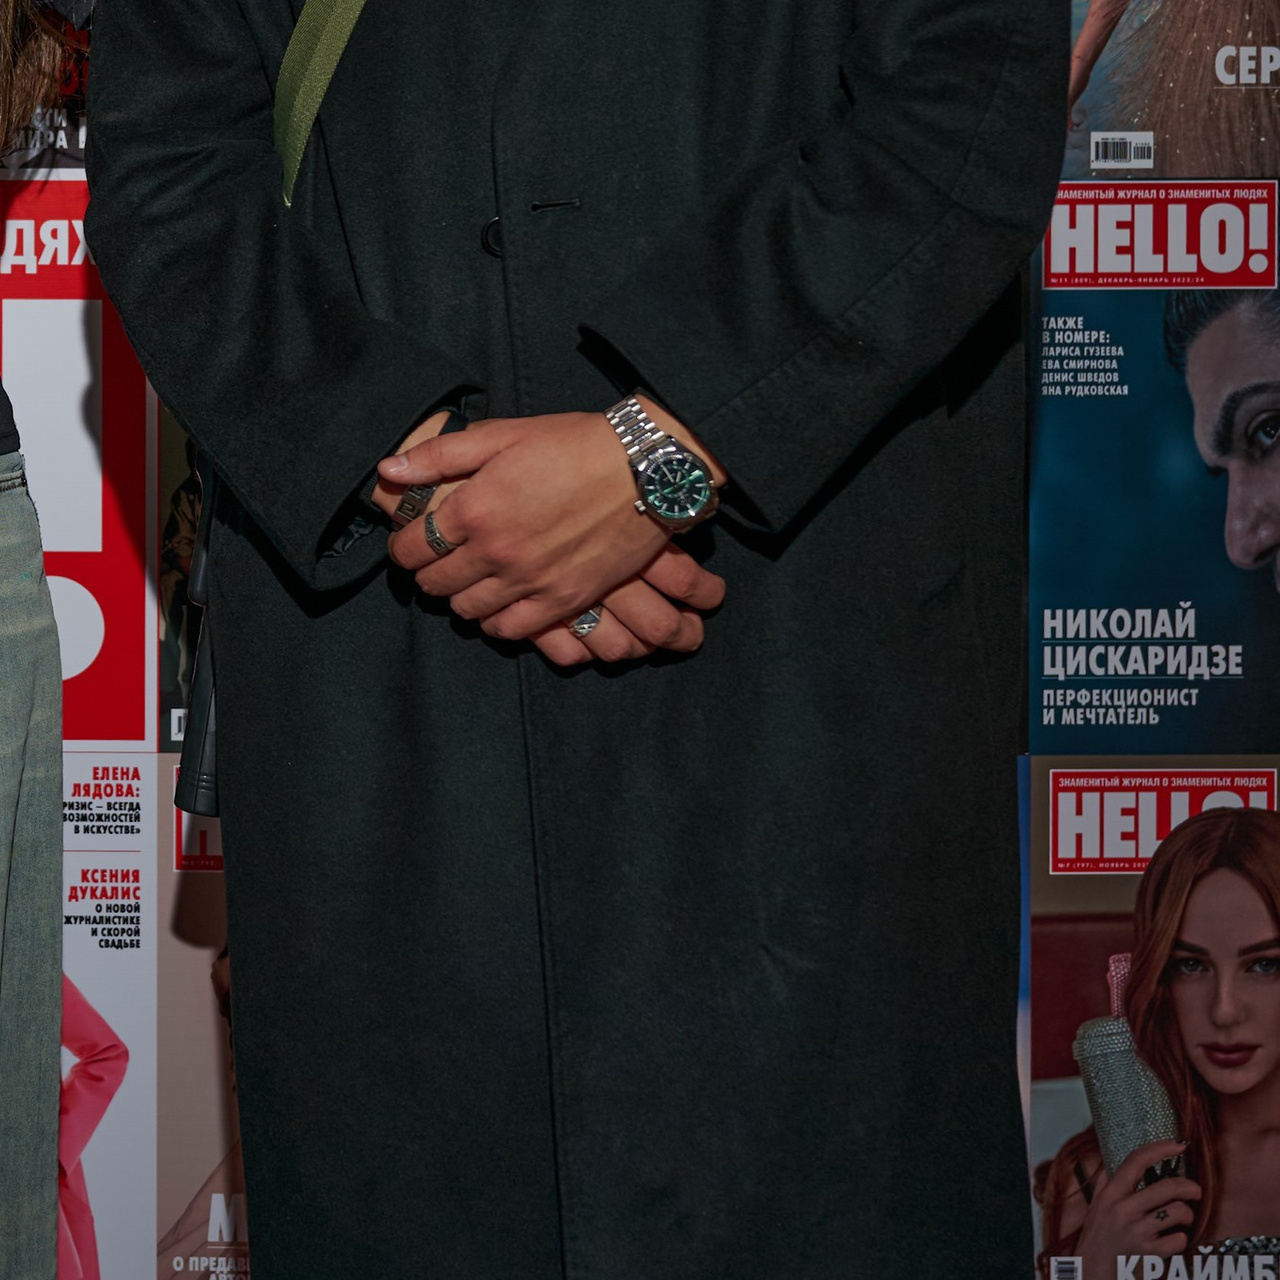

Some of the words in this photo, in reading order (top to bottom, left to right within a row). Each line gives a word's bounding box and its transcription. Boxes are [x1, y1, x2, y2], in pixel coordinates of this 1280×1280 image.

[1050, 202, 1269, 273] HELLO!
[1042, 346, 1081, 356] ЛАРИСА
[1083, 346, 1124, 356] ГУЗЕЕВА
[1042, 360, 1060, 369] ЕВА
[1063, 360, 1118, 369] СМИРНОВА
[1042, 372, 1074, 384] ДЕНИС
[1077, 372, 1119, 383] ШВЕДОВ
[1042, 385, 1062, 395] ЯНА
[1065, 385, 1128, 397] РУДКОВСКАЯ
[1043, 601, 1196, 639] НИКОЛАЙ
[1043, 645, 1243, 681] ЦИСКАРИДЗЕ
[1042, 688, 1199, 709] ПЕРФЕКЦИОНИСТ
[1042, 708, 1055, 725] И
[1061, 708, 1160, 725] МЕЧТАТЕЛЬ
[92, 767, 141, 781] ЕЛЕНА
[71, 783, 140, 799] ЛЯДОВА:
[106, 801, 141, 812] ВСЕГДА
[63, 812, 141, 823] ВОЗМОЖНОСТЕЙ
[81, 869, 140, 883] КСЕНИЯ
[68, 886, 141, 902] ДУКАЛИС
[106, 902, 141, 913] НОВОЙ
[63, 916, 141, 925] ЖУРНАЛИСТИКЕ
[101, 926, 141, 937] СКОРОЙ
[99, 939, 141, 950] СВАДЬБЕ
